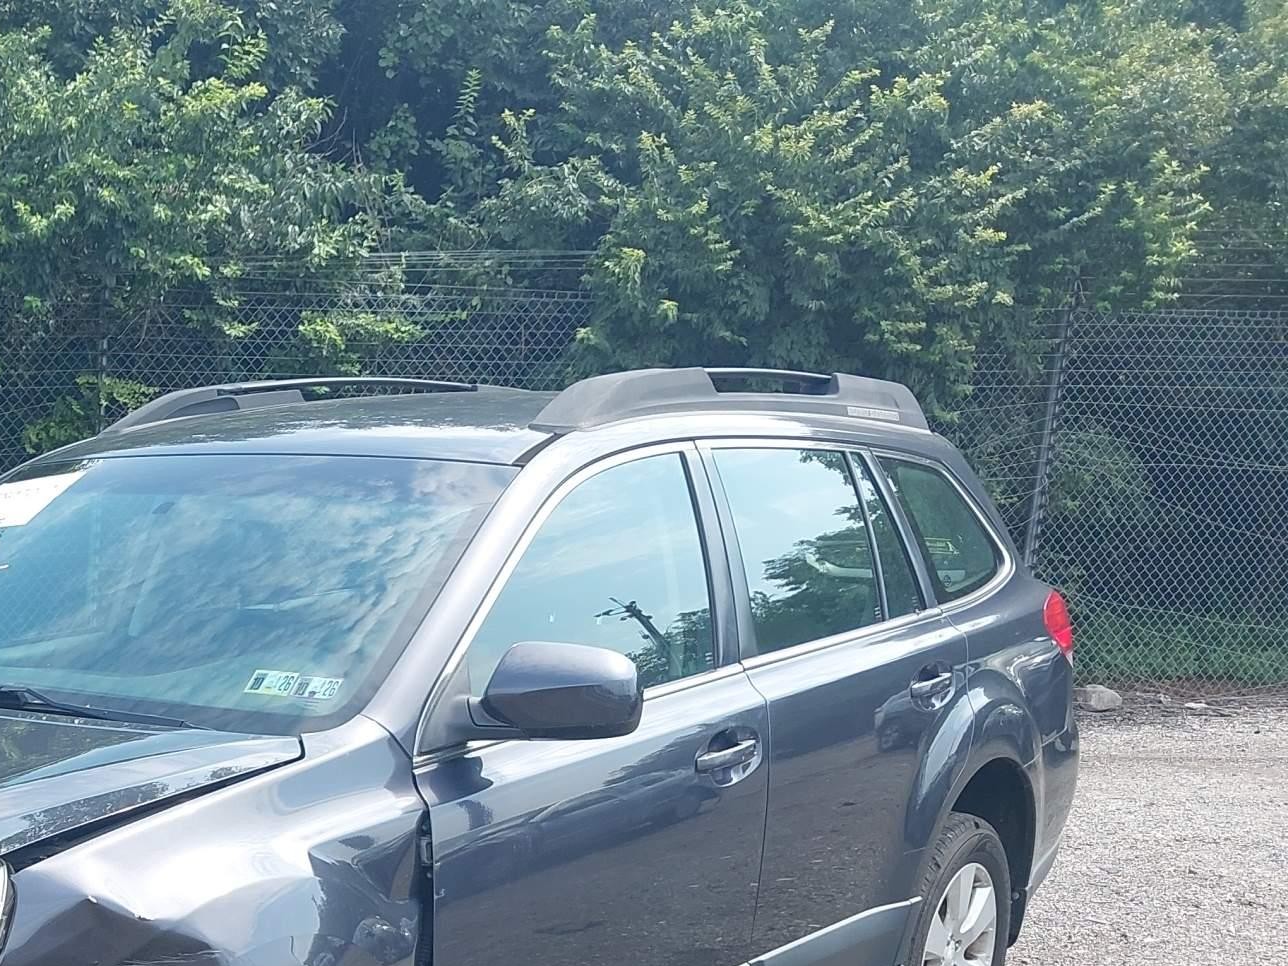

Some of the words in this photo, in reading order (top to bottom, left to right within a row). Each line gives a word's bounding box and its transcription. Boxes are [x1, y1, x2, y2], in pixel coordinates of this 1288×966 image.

[249, 676, 266, 691] 10
[277, 675, 295, 692] 26
[322, 680, 340, 697] 26
